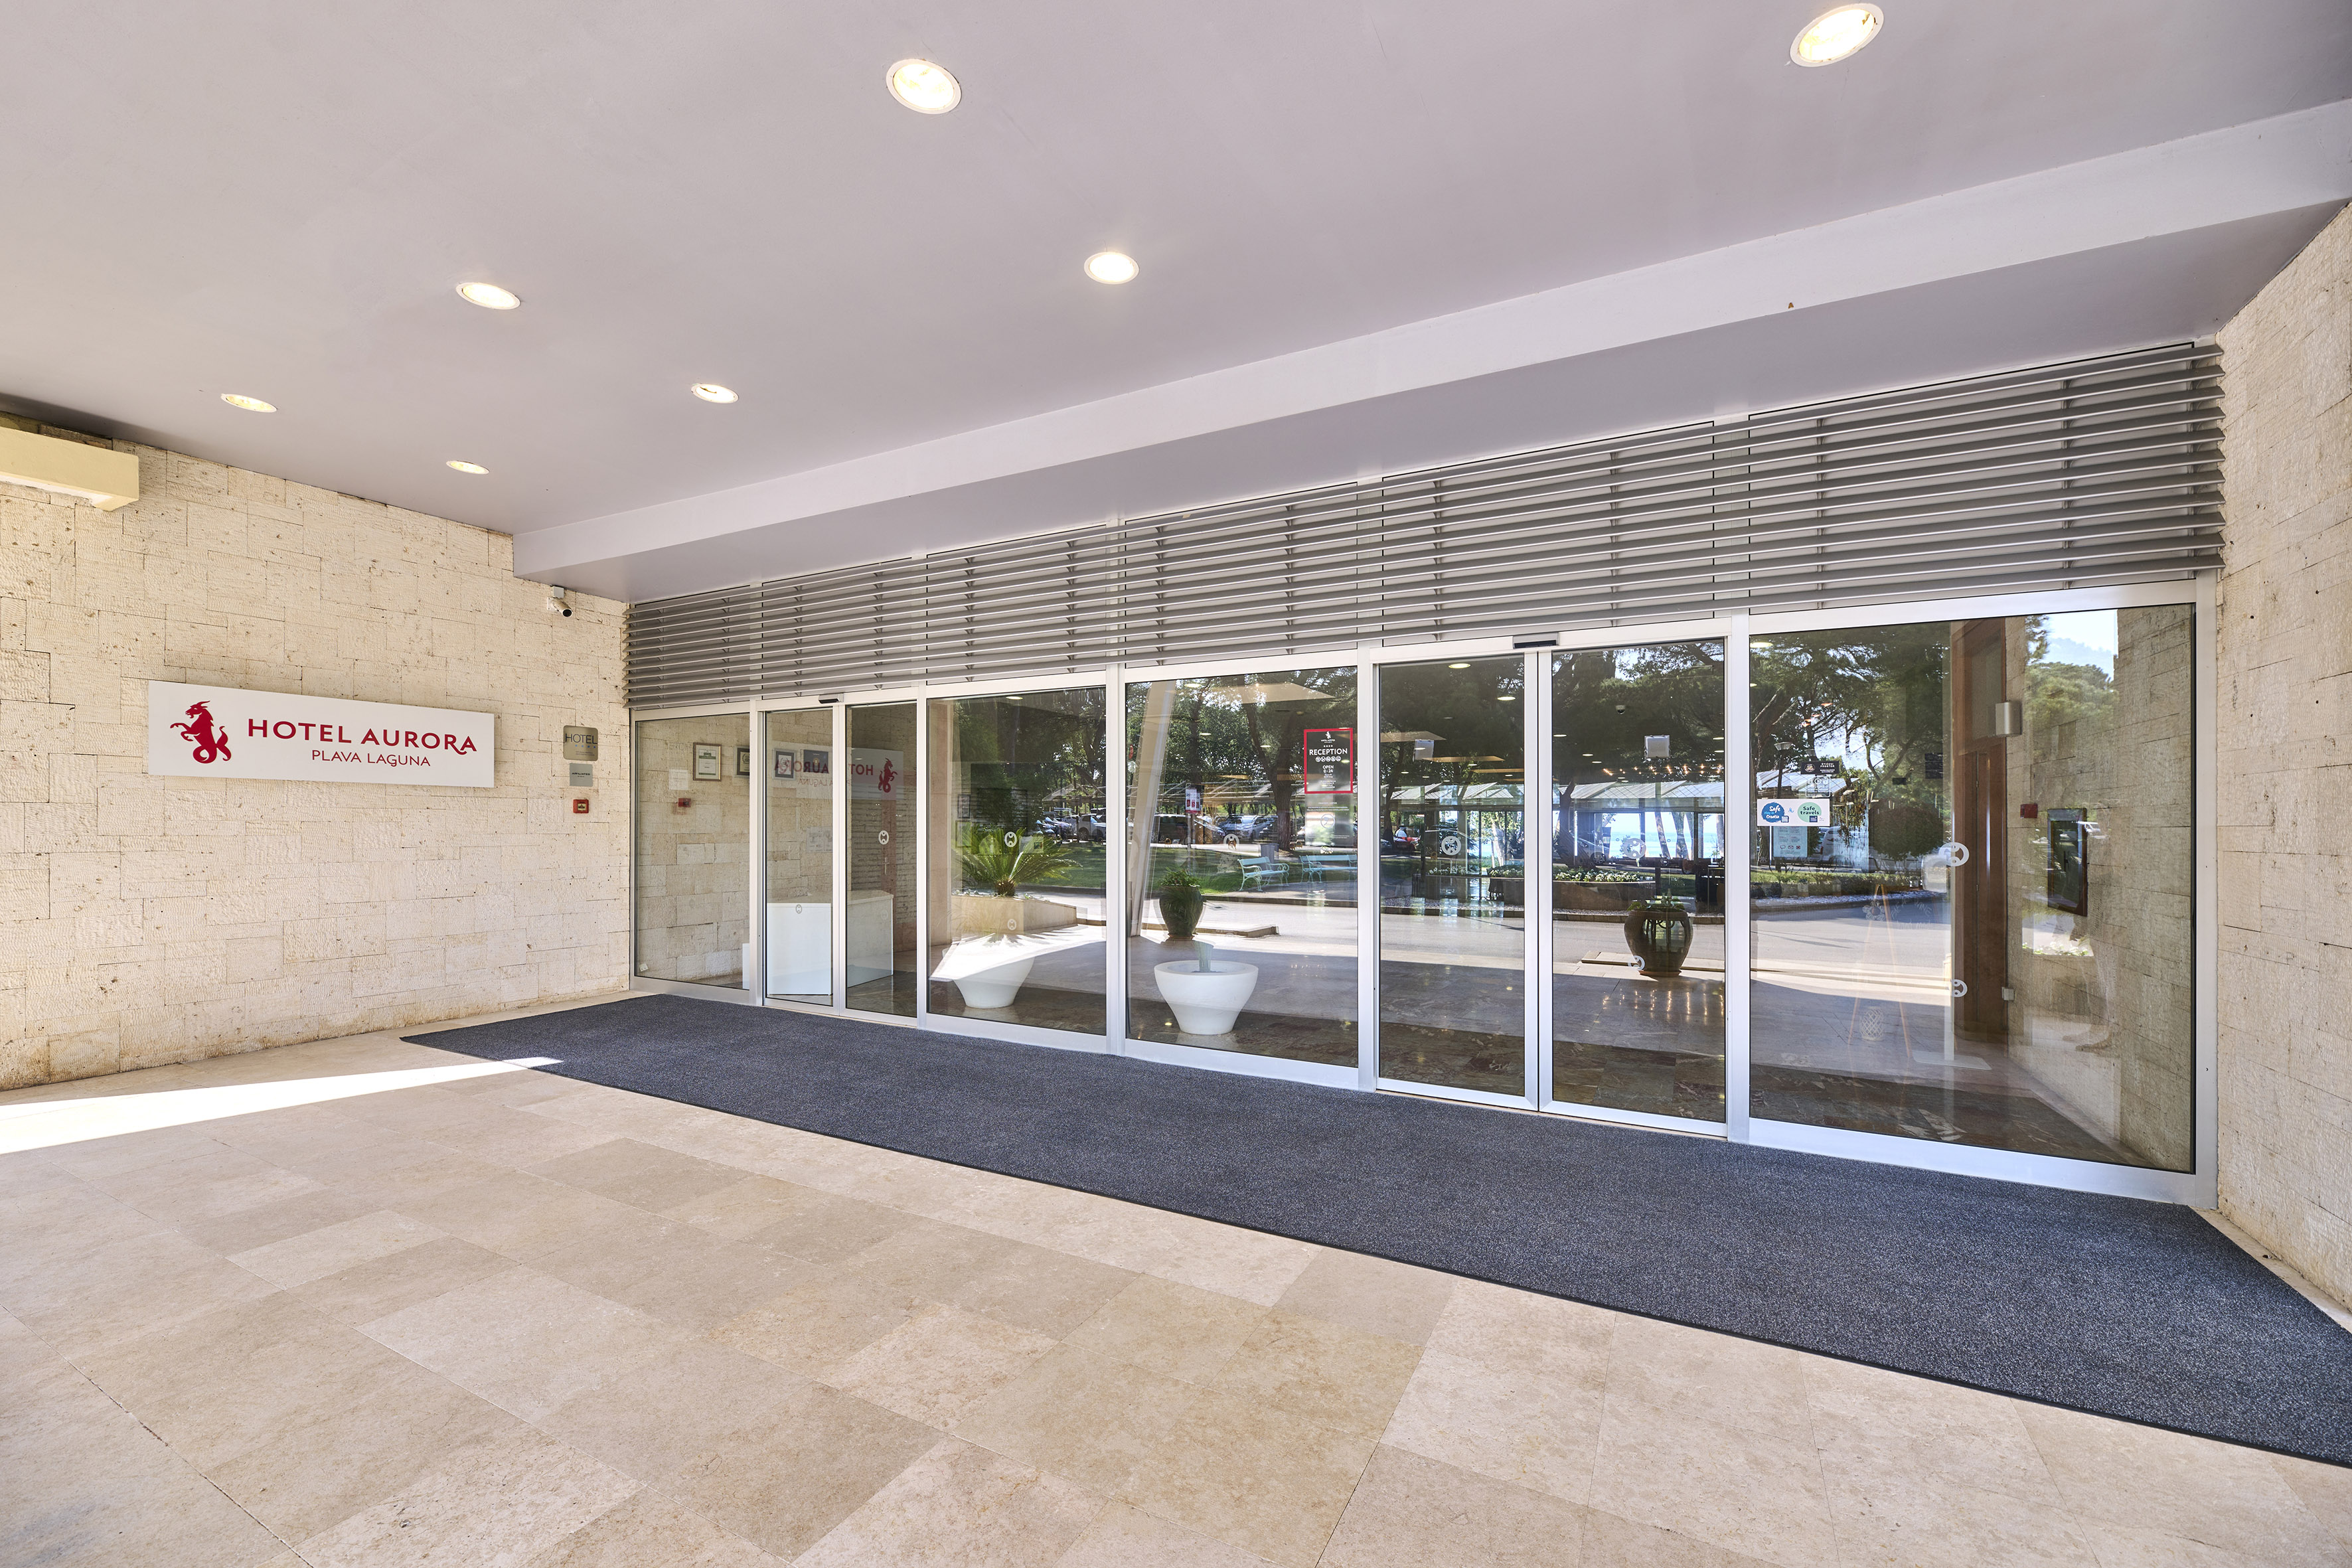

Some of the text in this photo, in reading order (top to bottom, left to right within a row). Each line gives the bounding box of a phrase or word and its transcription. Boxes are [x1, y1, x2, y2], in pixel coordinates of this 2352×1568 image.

[248, 719, 477, 755] HOTEL AURORA
[565, 734, 597, 744] HOTEL
[312, 749, 431, 767] PLAVA LAGUNA
